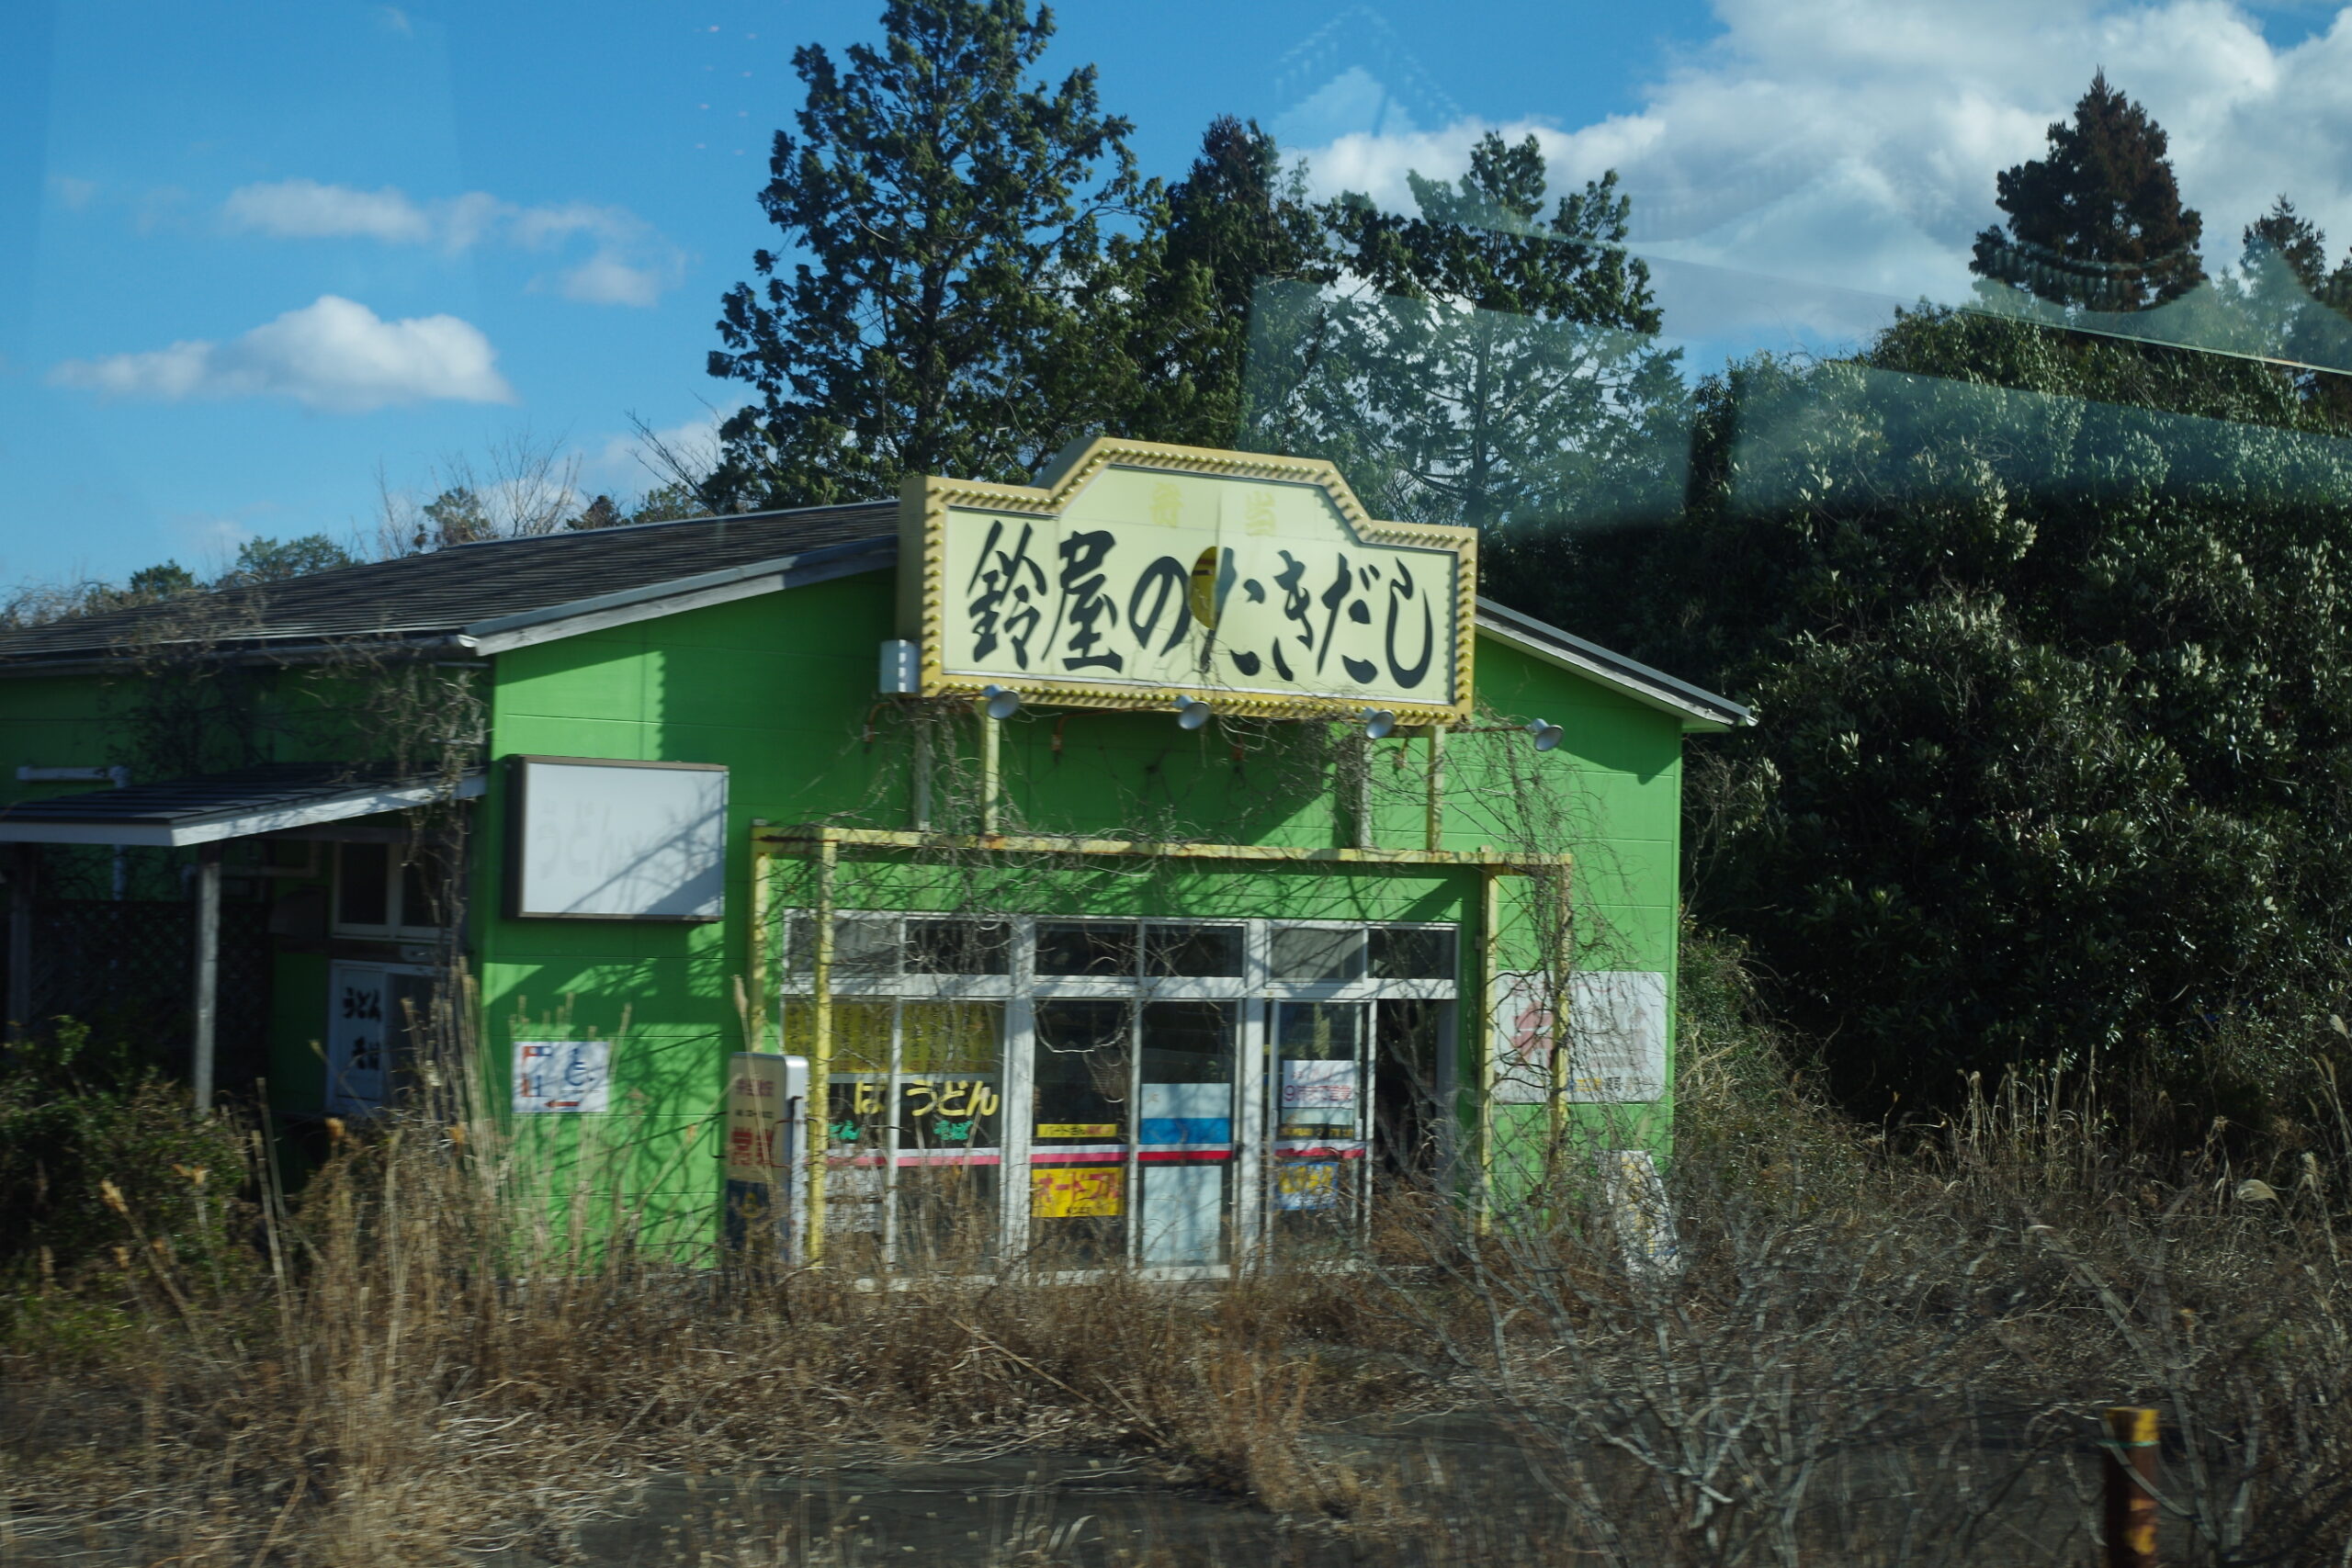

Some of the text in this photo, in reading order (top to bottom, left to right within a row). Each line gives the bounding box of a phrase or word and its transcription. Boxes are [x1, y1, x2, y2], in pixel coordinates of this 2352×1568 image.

[967, 520, 1433, 689] 鈴屋のたきだし
[906, 1078, 1000, 1117] うどん
